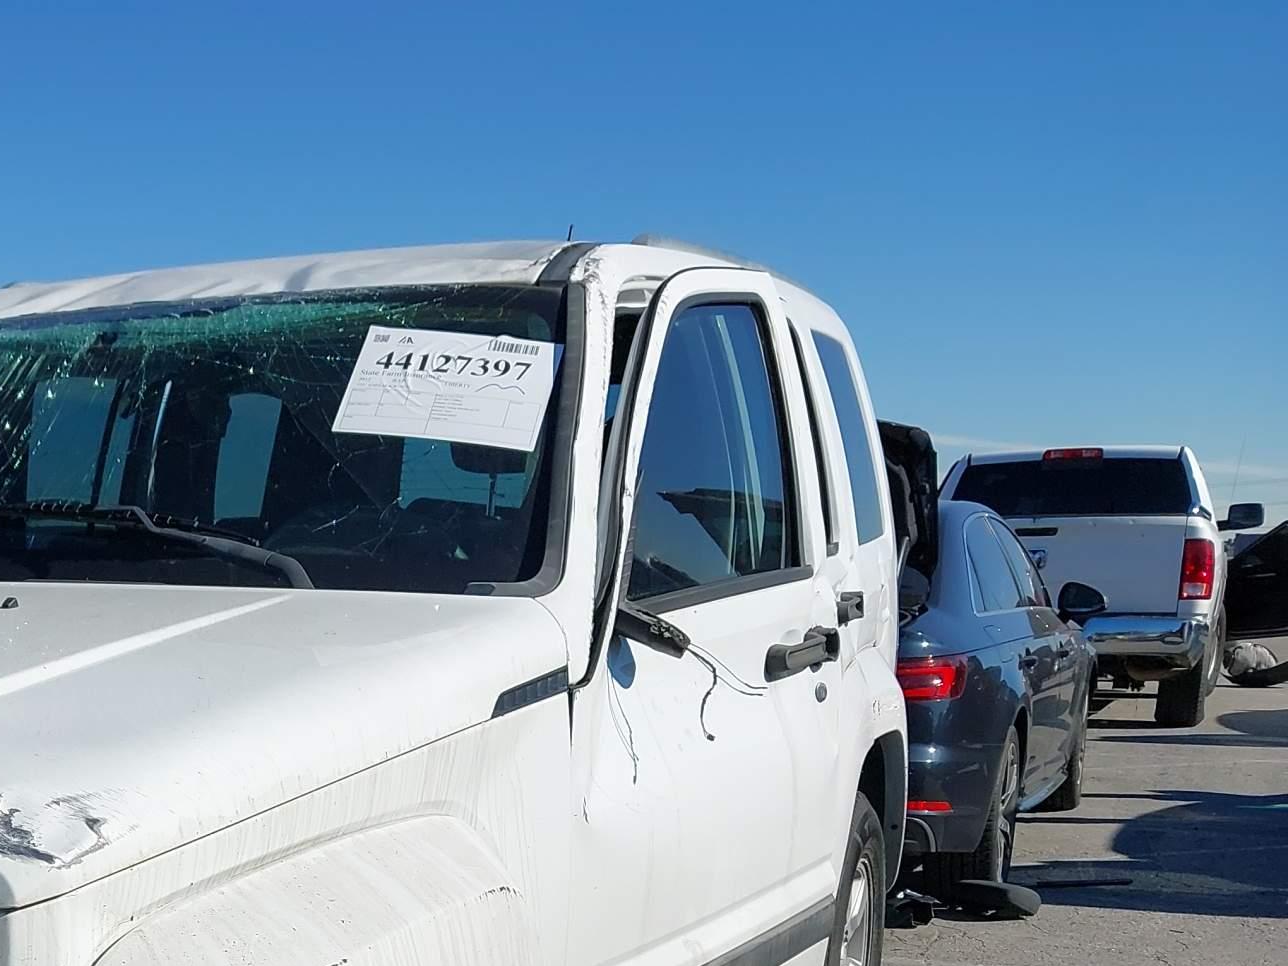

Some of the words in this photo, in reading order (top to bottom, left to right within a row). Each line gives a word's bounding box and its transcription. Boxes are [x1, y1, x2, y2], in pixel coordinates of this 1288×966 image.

[360, 369, 380, 377] State
[381, 370, 403, 378] Farm
[375, 351, 532, 381] 44127397
